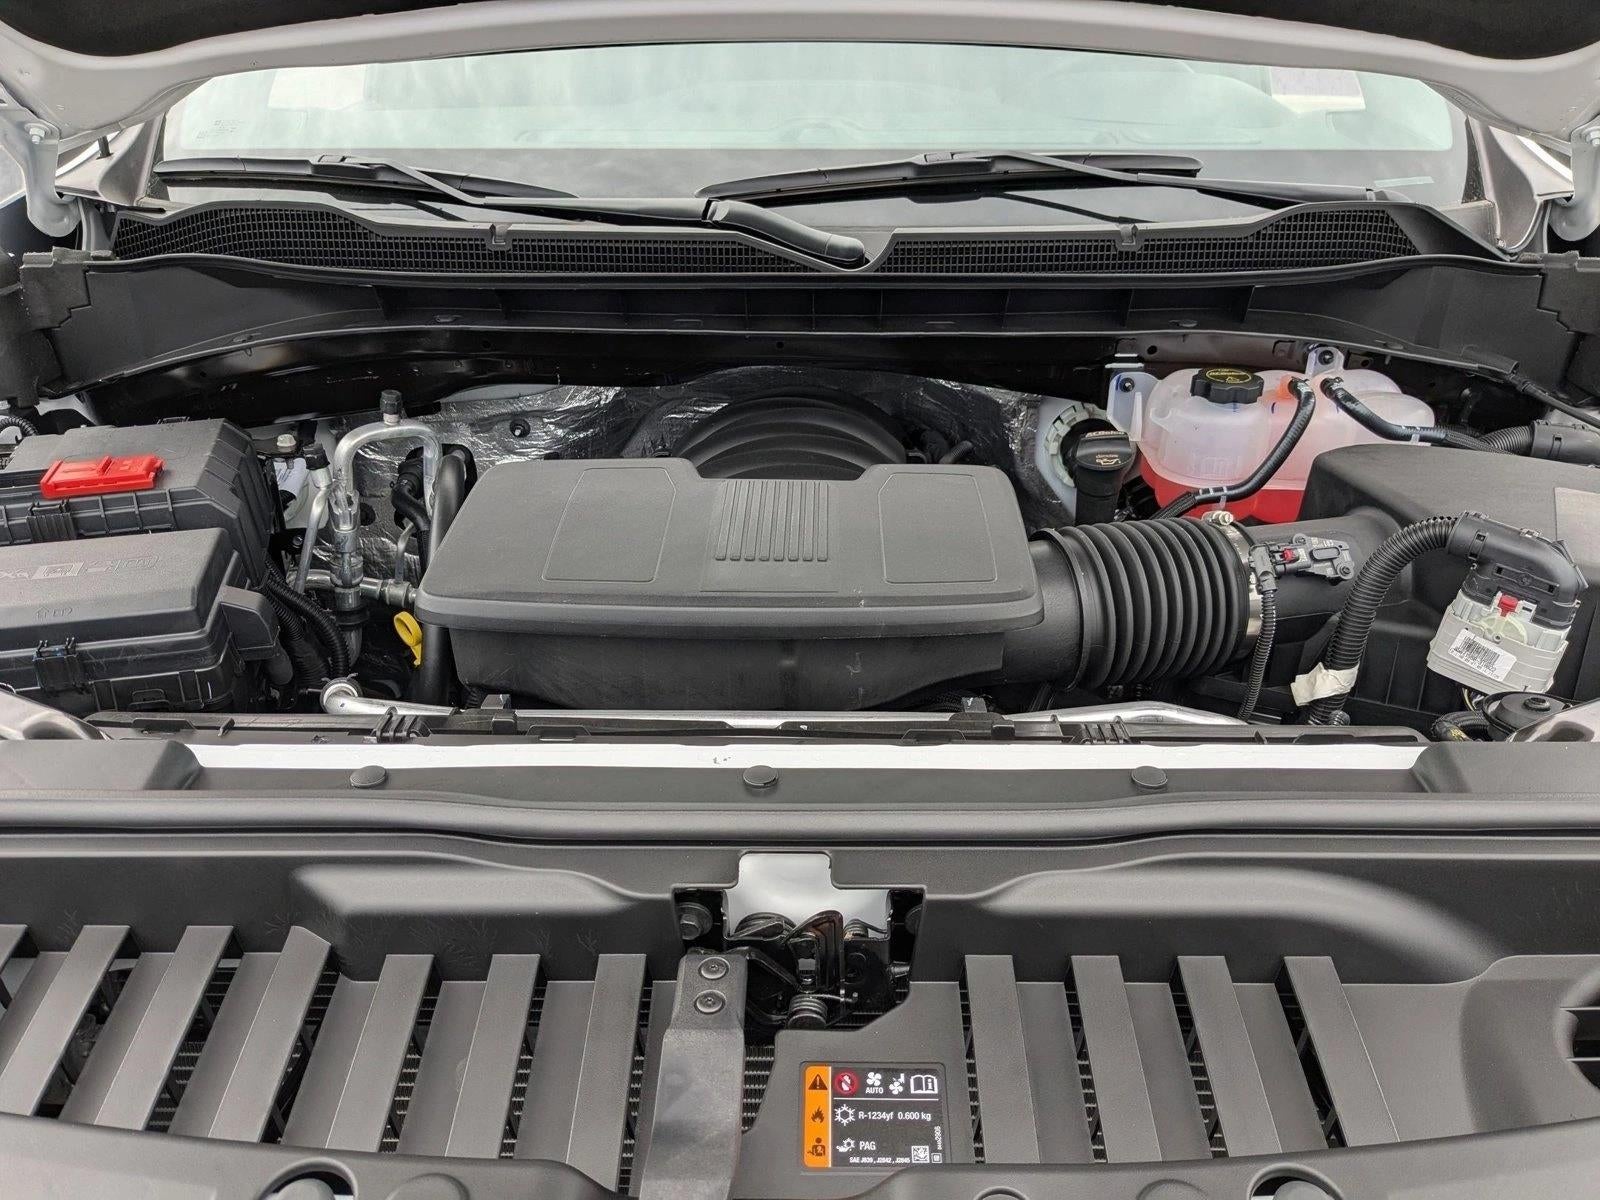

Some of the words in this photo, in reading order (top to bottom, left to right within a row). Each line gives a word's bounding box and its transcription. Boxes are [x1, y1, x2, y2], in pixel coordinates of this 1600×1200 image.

[858, 1111, 894, 1121] R-1234yf
[897, 1111, 920, 1120] 0.600
[921, 1112, 932, 1122] kg
[859, 1141, 876, 1150] PAG
